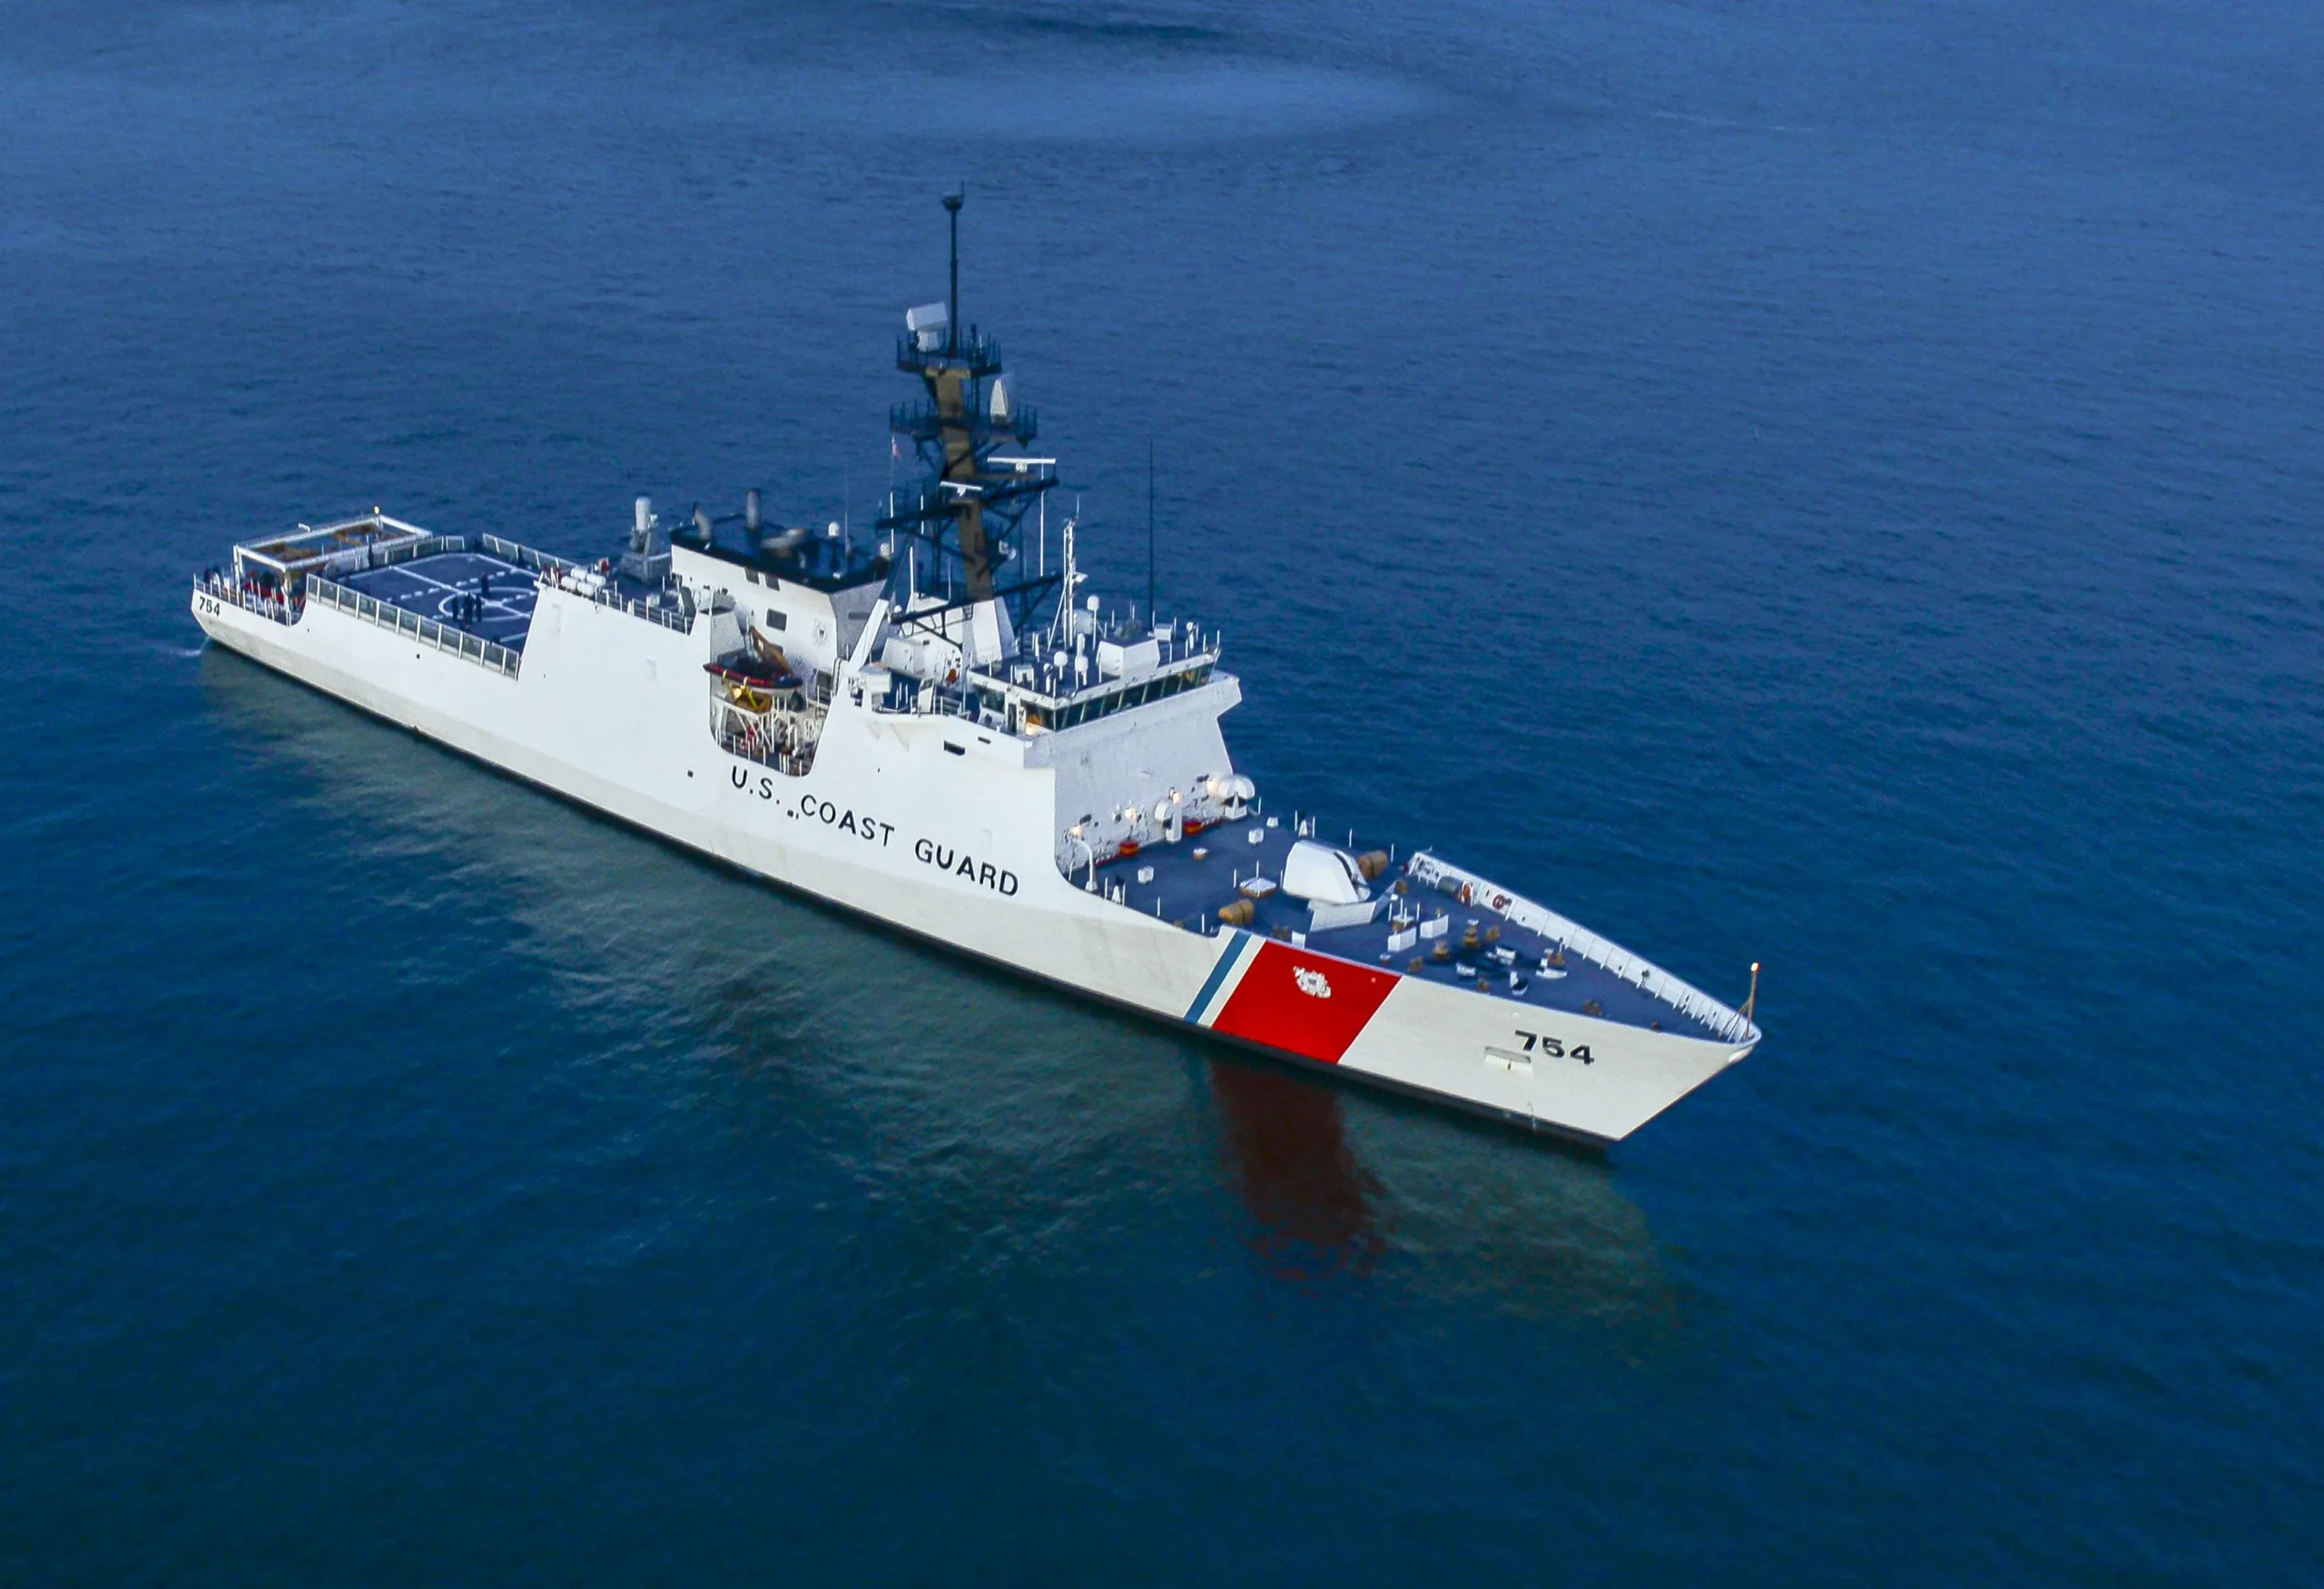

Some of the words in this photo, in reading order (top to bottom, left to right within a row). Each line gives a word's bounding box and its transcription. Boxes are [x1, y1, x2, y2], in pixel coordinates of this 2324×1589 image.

[732, 765, 781, 804] U.S.
[801, 794, 895, 847] COAST
[914, 838, 1019, 897] GUARD
[1514, 1030, 1595, 1065] 754
